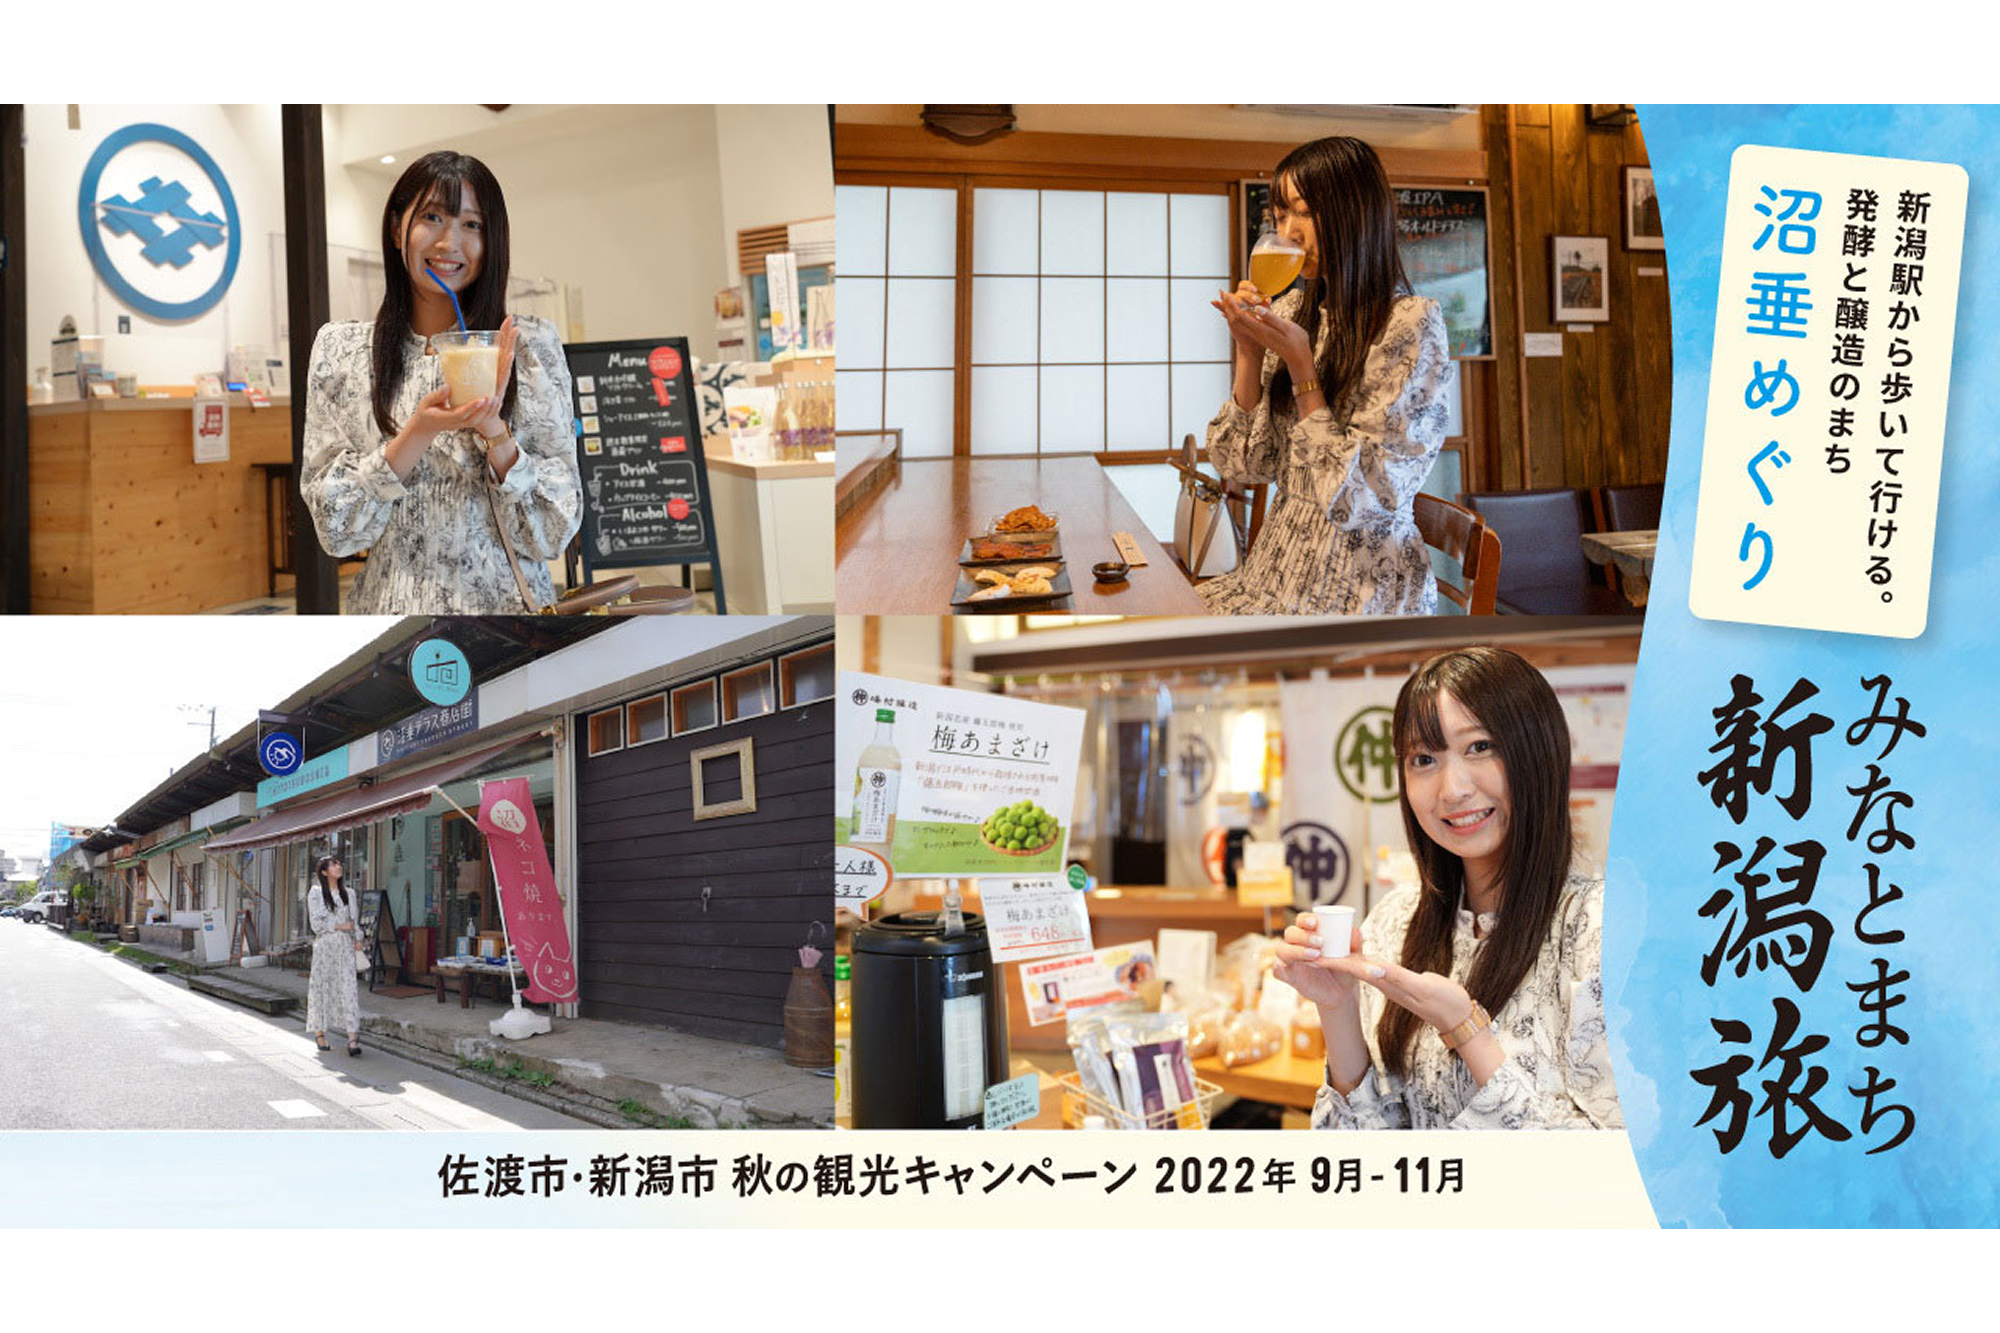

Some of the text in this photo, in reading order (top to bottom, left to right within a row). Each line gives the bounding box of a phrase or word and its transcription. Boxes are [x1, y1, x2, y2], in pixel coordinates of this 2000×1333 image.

[608, 352, 647, 368] Menu
[619, 460, 659, 476] Drink
[622, 504, 669, 522] Alcohol
[931, 724, 1050, 760] 梅あまざけ
[517, 838, 543, 904] ネコ焼
[1006, 904, 1069, 922] 梅あまざけ
